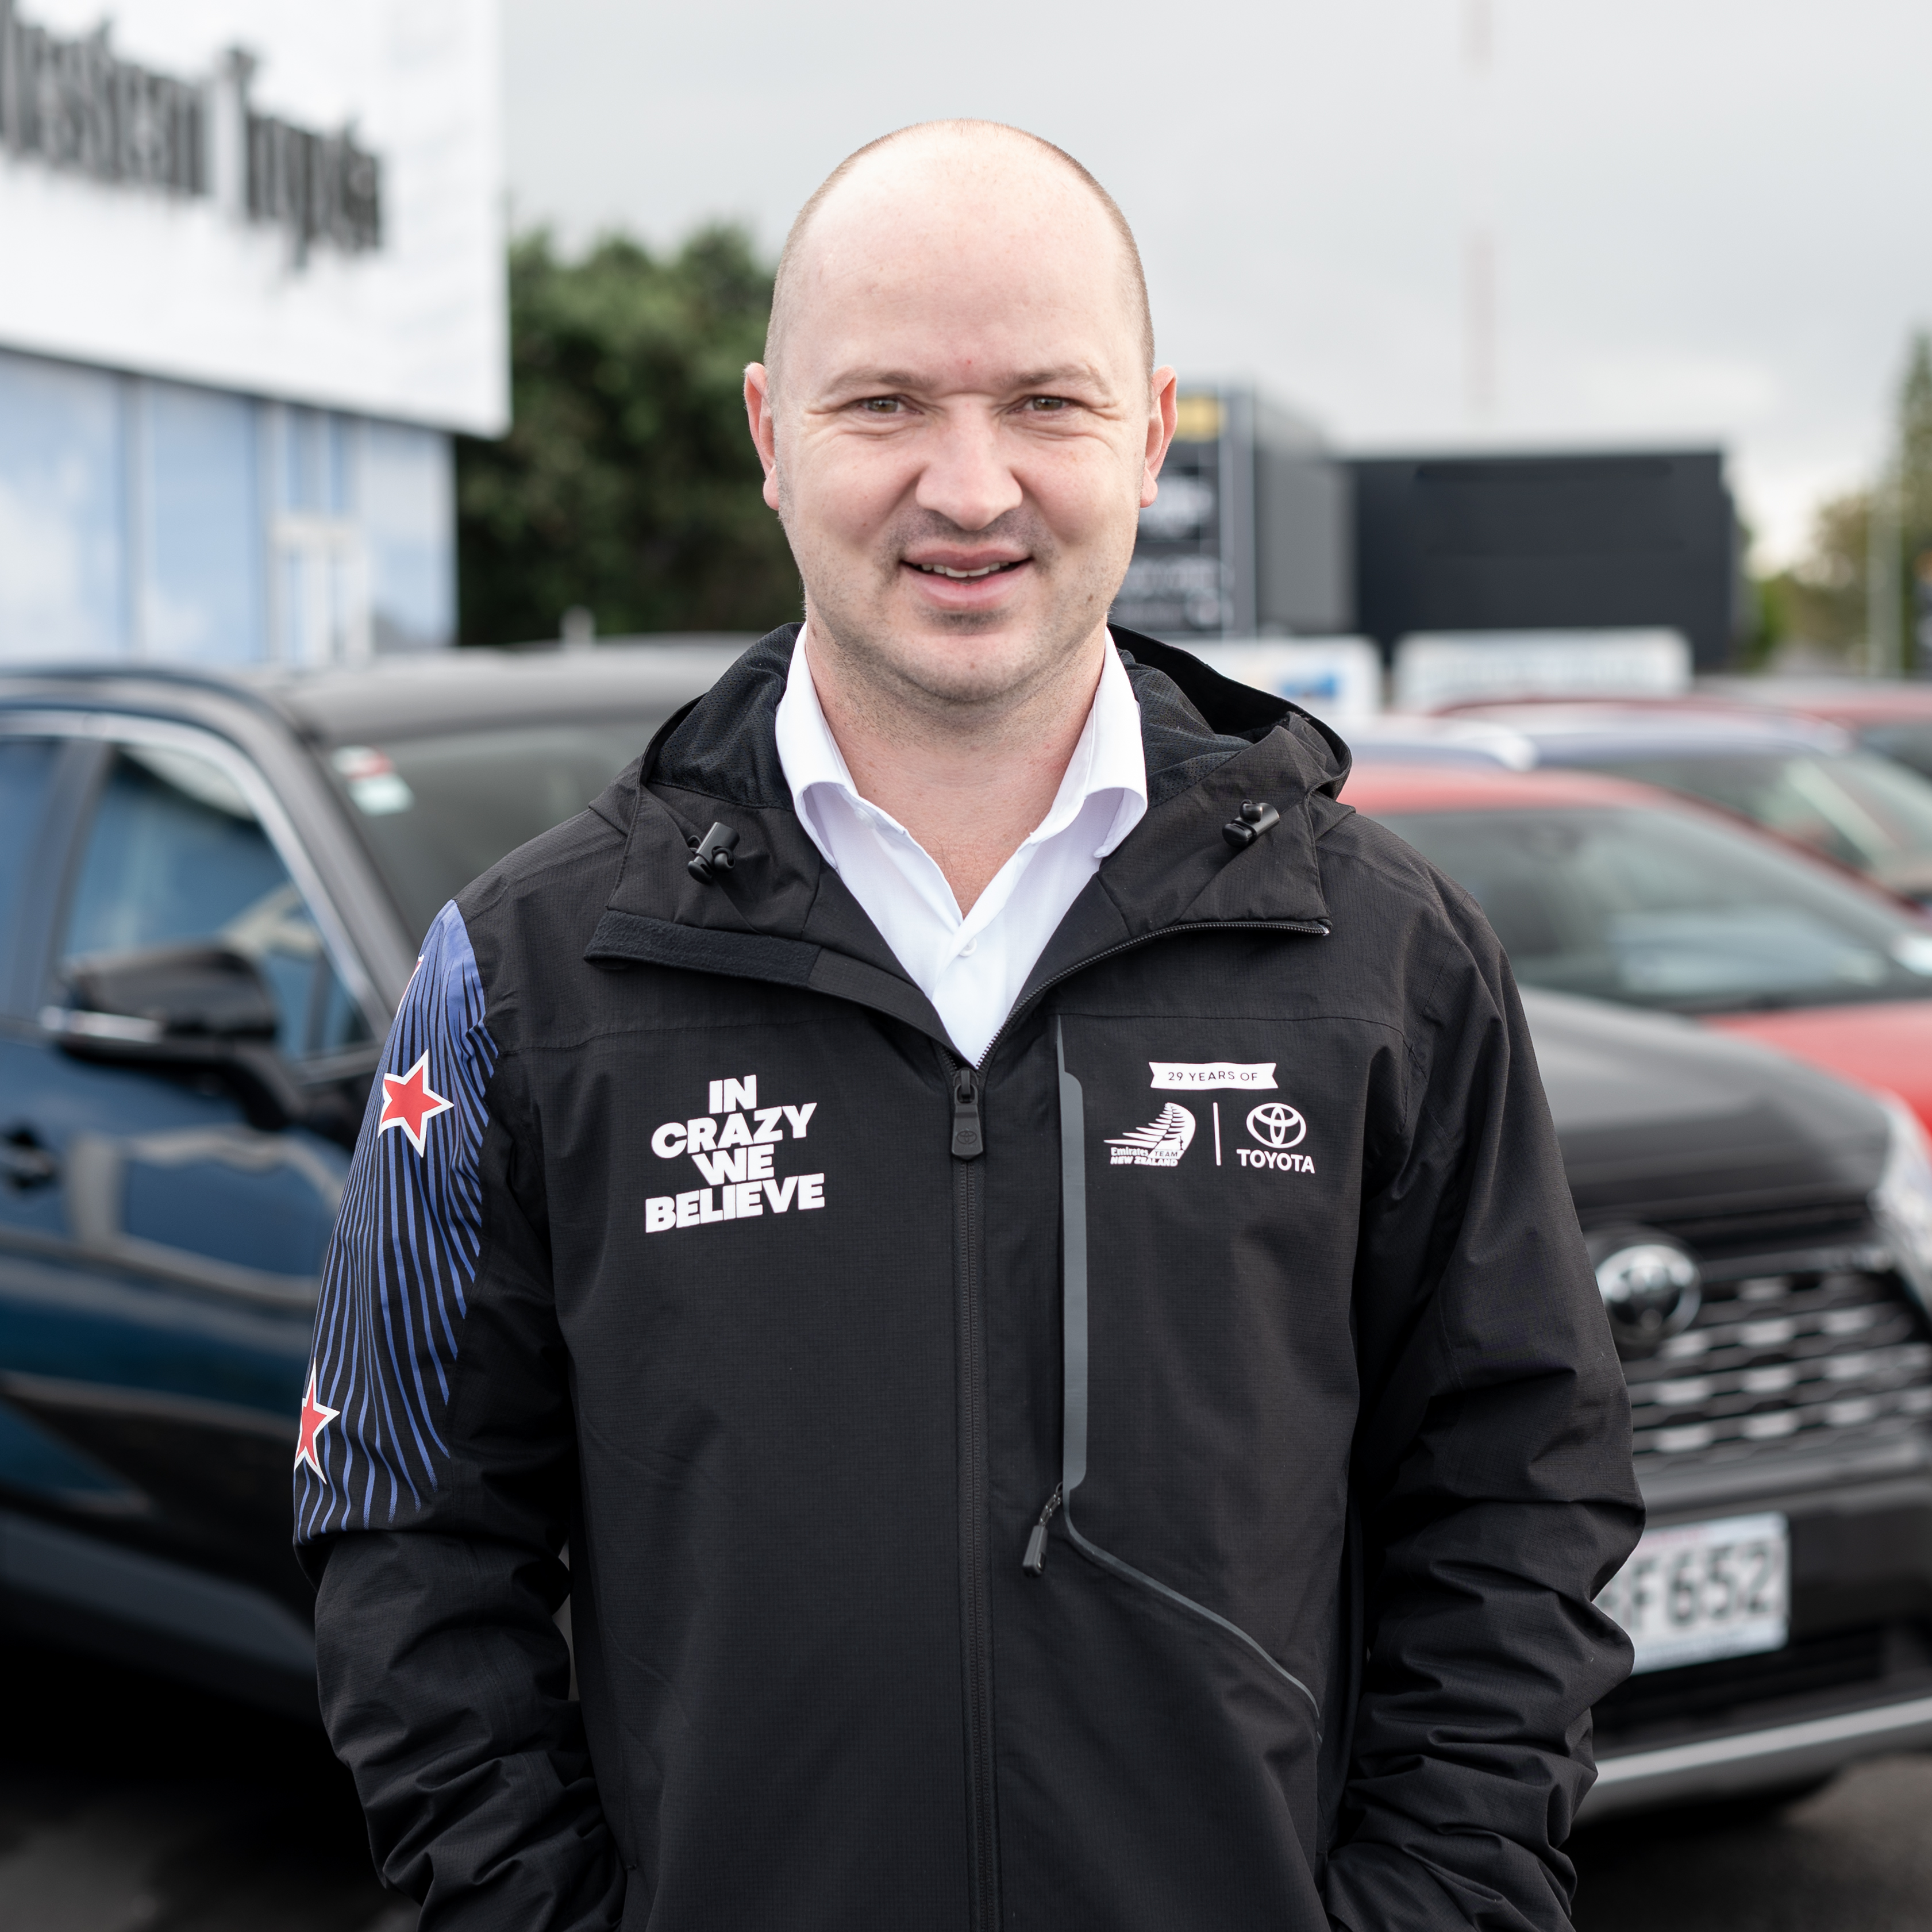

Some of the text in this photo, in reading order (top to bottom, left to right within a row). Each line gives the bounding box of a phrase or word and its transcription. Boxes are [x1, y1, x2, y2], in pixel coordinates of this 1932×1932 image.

[709, 1075, 757, 1114] IN
[1168, 1071, 1257, 1081] 29 YEARS OF
[651, 1103, 817, 1159] CRAZY
[691, 1144, 774, 1186] WE
[1110, 1146, 1149, 1157] Emirates
[1110, 1156, 1178, 1167] NEW ZEALAND
[1236, 1149, 1315, 1174] TOYOTA
[645, 1173, 825, 1233] BELIEVE
[1594, 1541, 1771, 1631] F652
